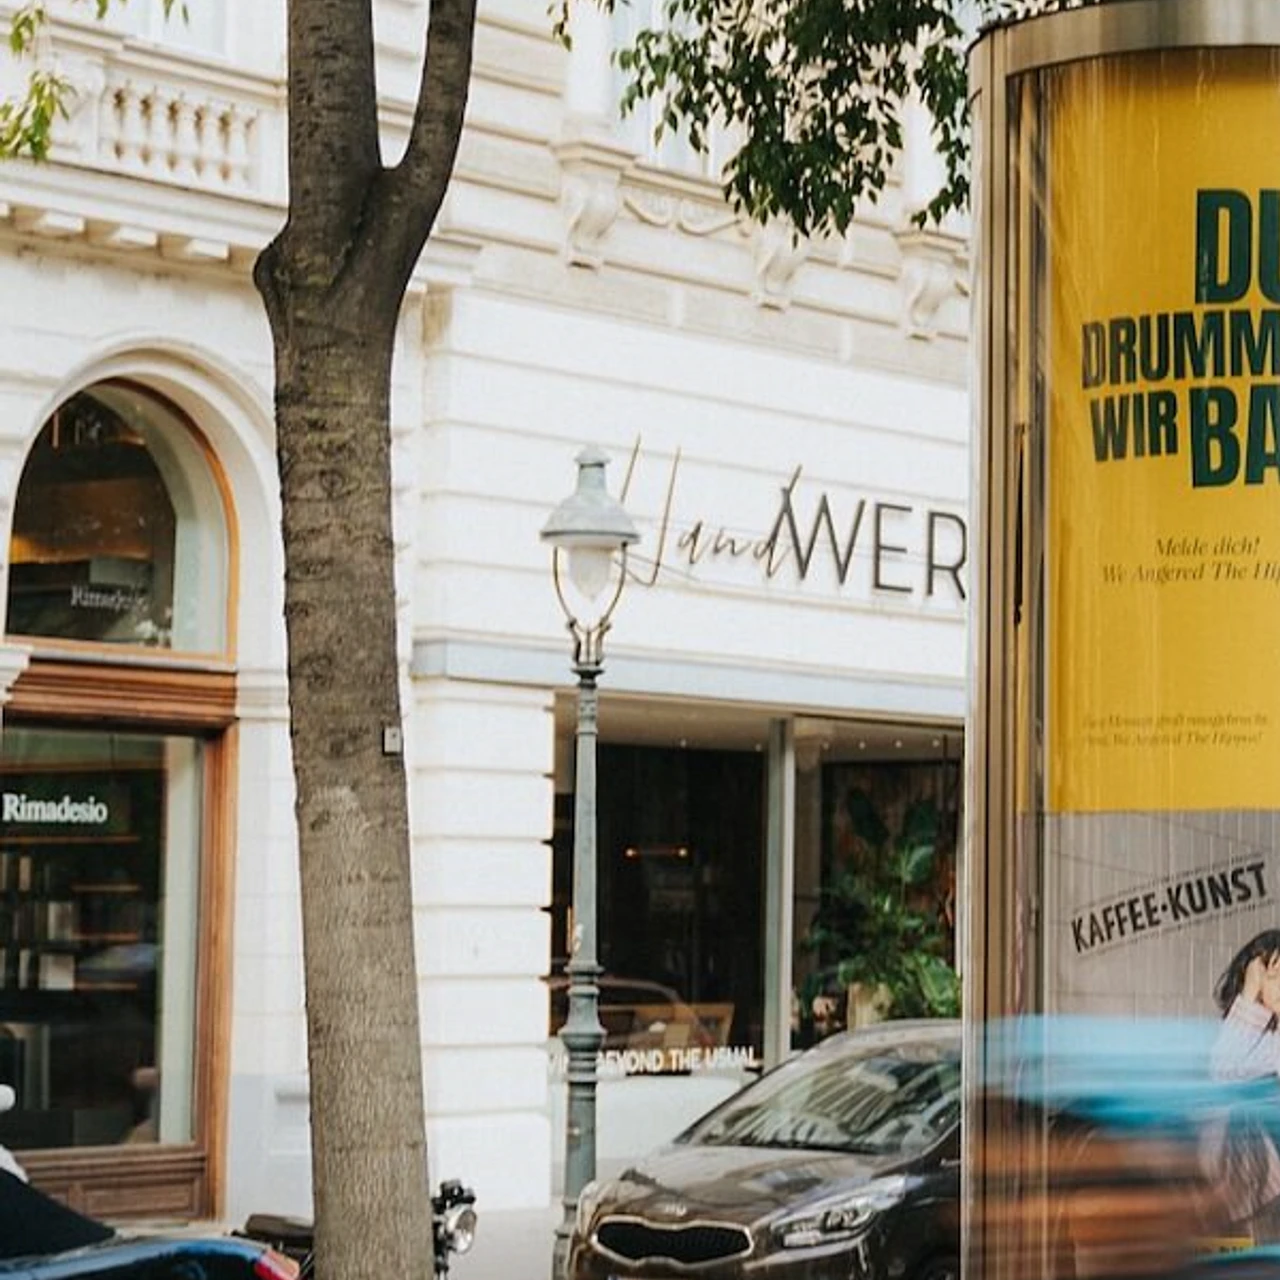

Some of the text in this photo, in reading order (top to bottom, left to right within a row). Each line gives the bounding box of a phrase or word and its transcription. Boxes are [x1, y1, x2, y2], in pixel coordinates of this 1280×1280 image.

[1090, 391, 1178, 462] WIR
[1155, 535, 1261, 557] Melde dich!
[1211, 561, 1248, 581] The
[2, 793, 108, 823] Rimadesio
[670, 1046, 701, 1071] THE
